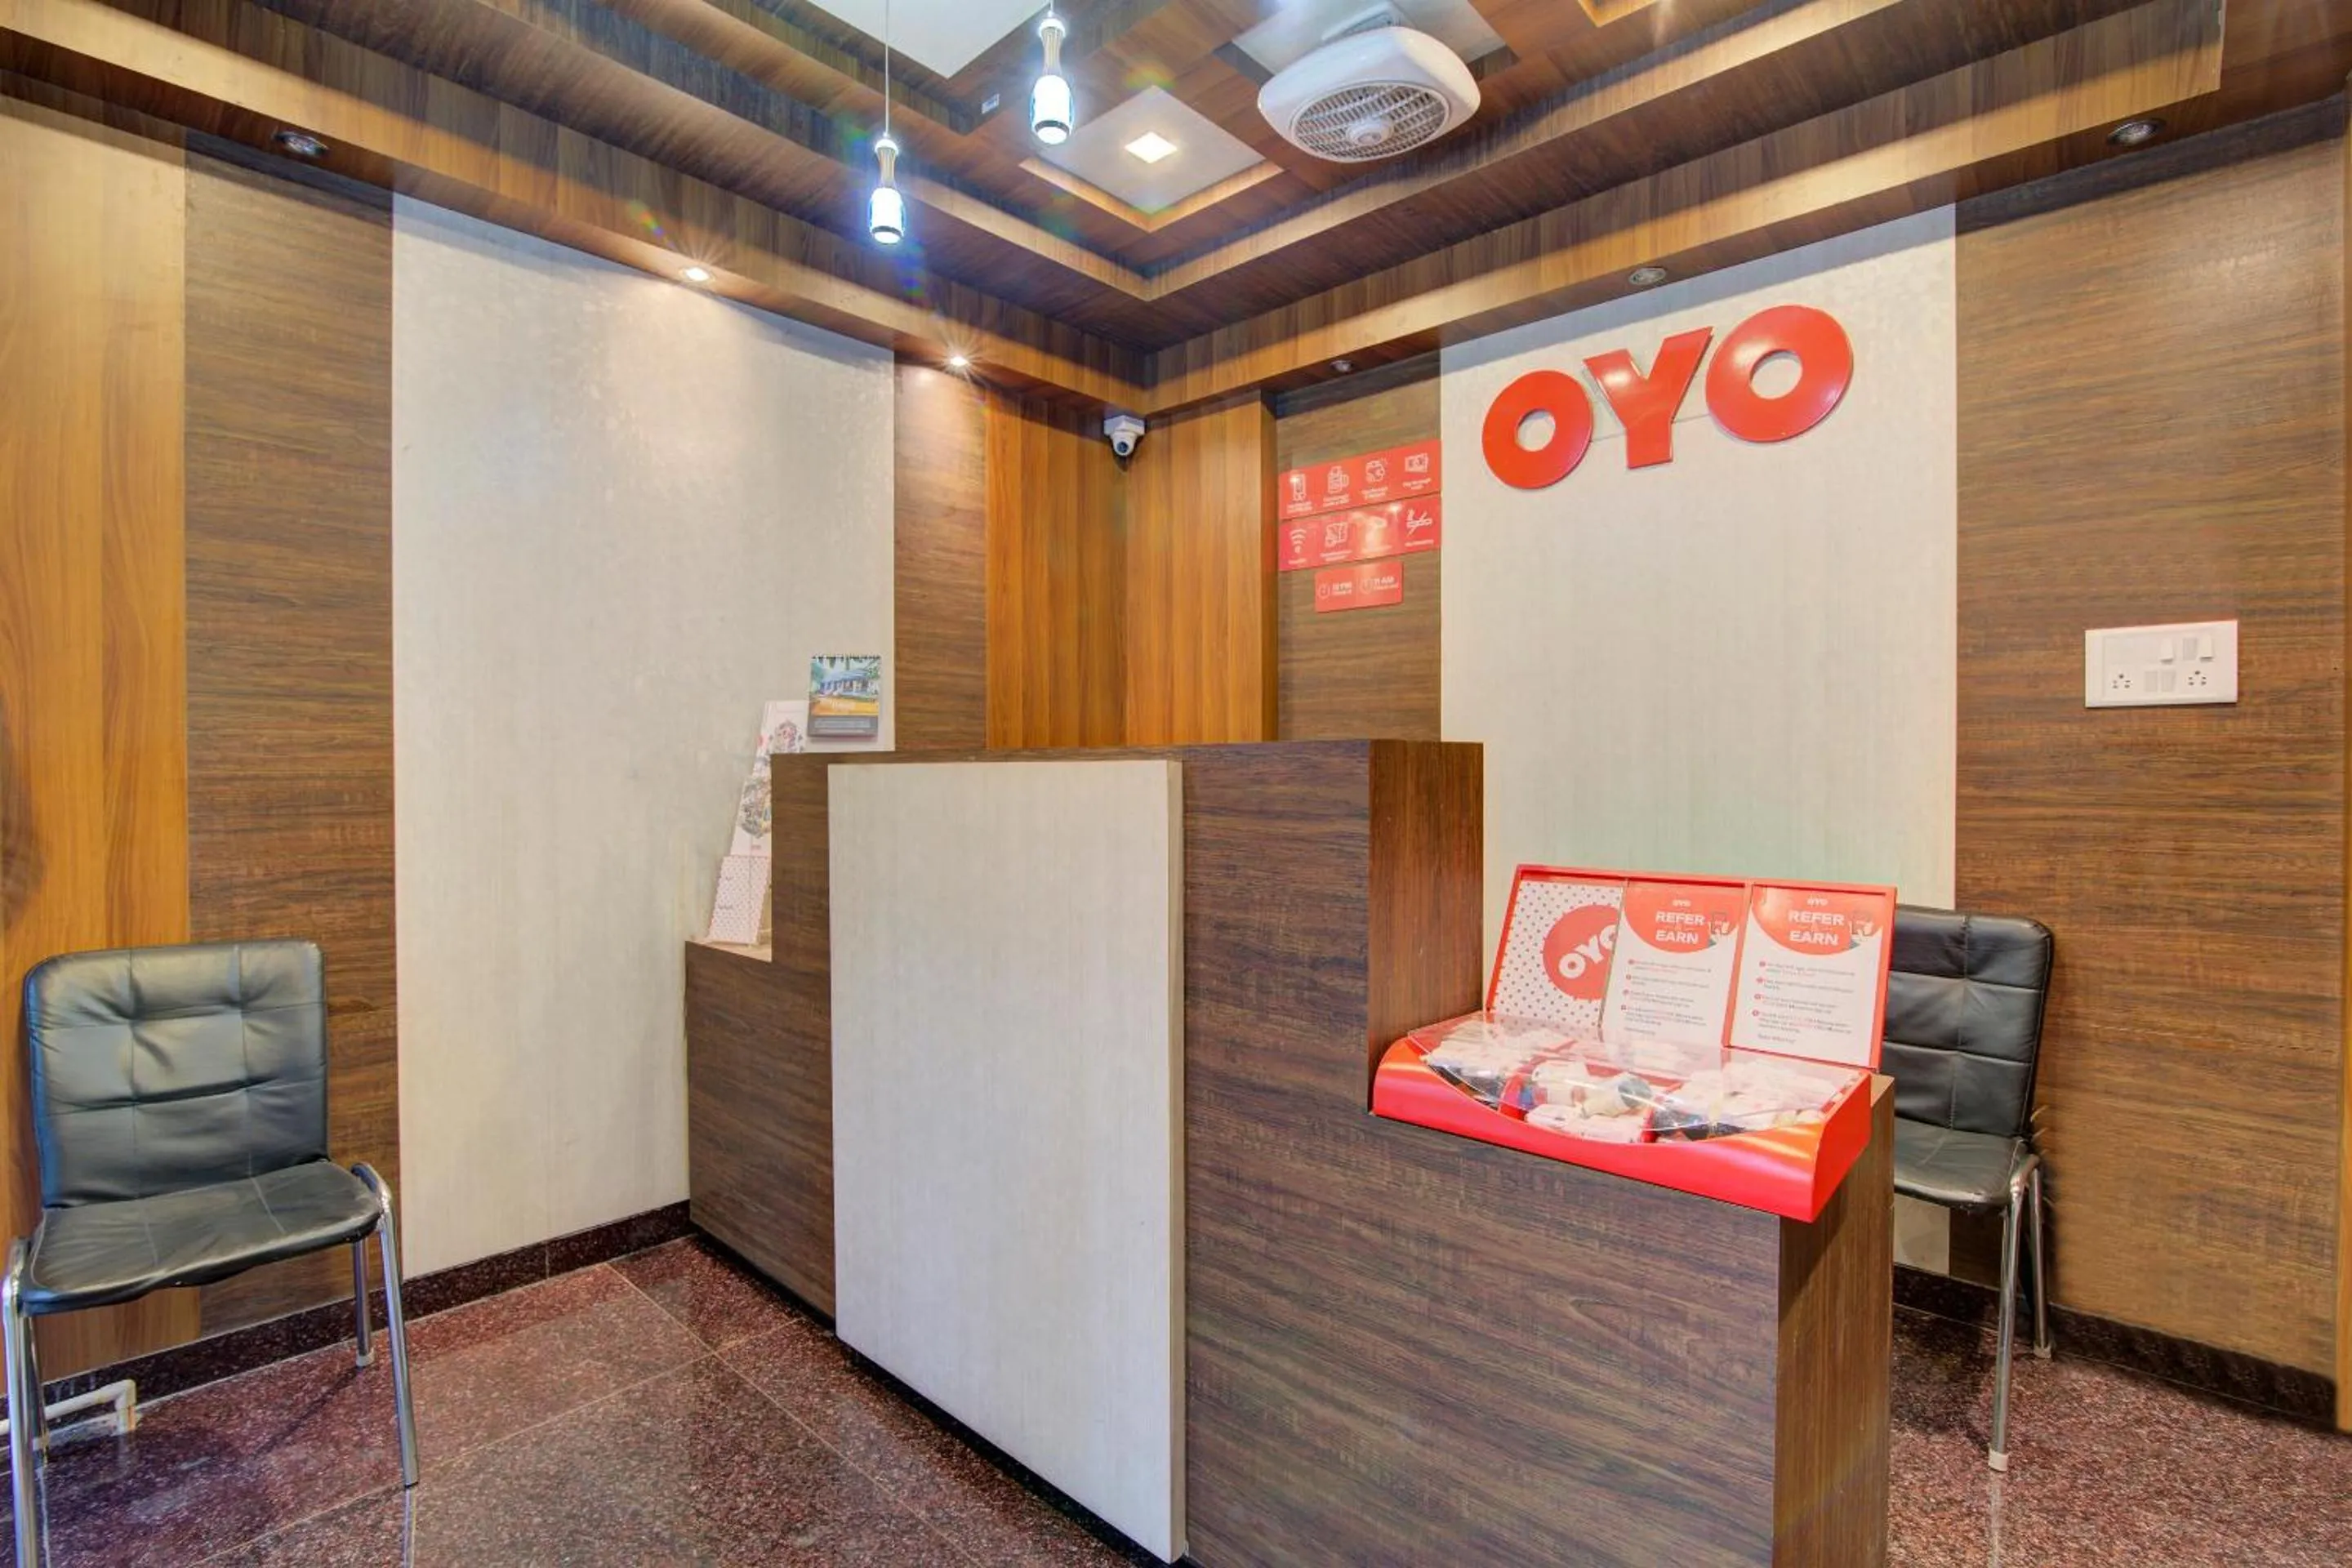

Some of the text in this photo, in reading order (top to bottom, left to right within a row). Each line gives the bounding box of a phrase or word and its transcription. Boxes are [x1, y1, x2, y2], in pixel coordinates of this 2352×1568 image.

[1481, 304, 1855, 490] OYO
[1655, 911, 1706, 926] REFER
[1788, 909, 1845, 926] REFER
[1655, 929, 1699, 945] EARN
[1789, 930, 1839, 947] EARN
